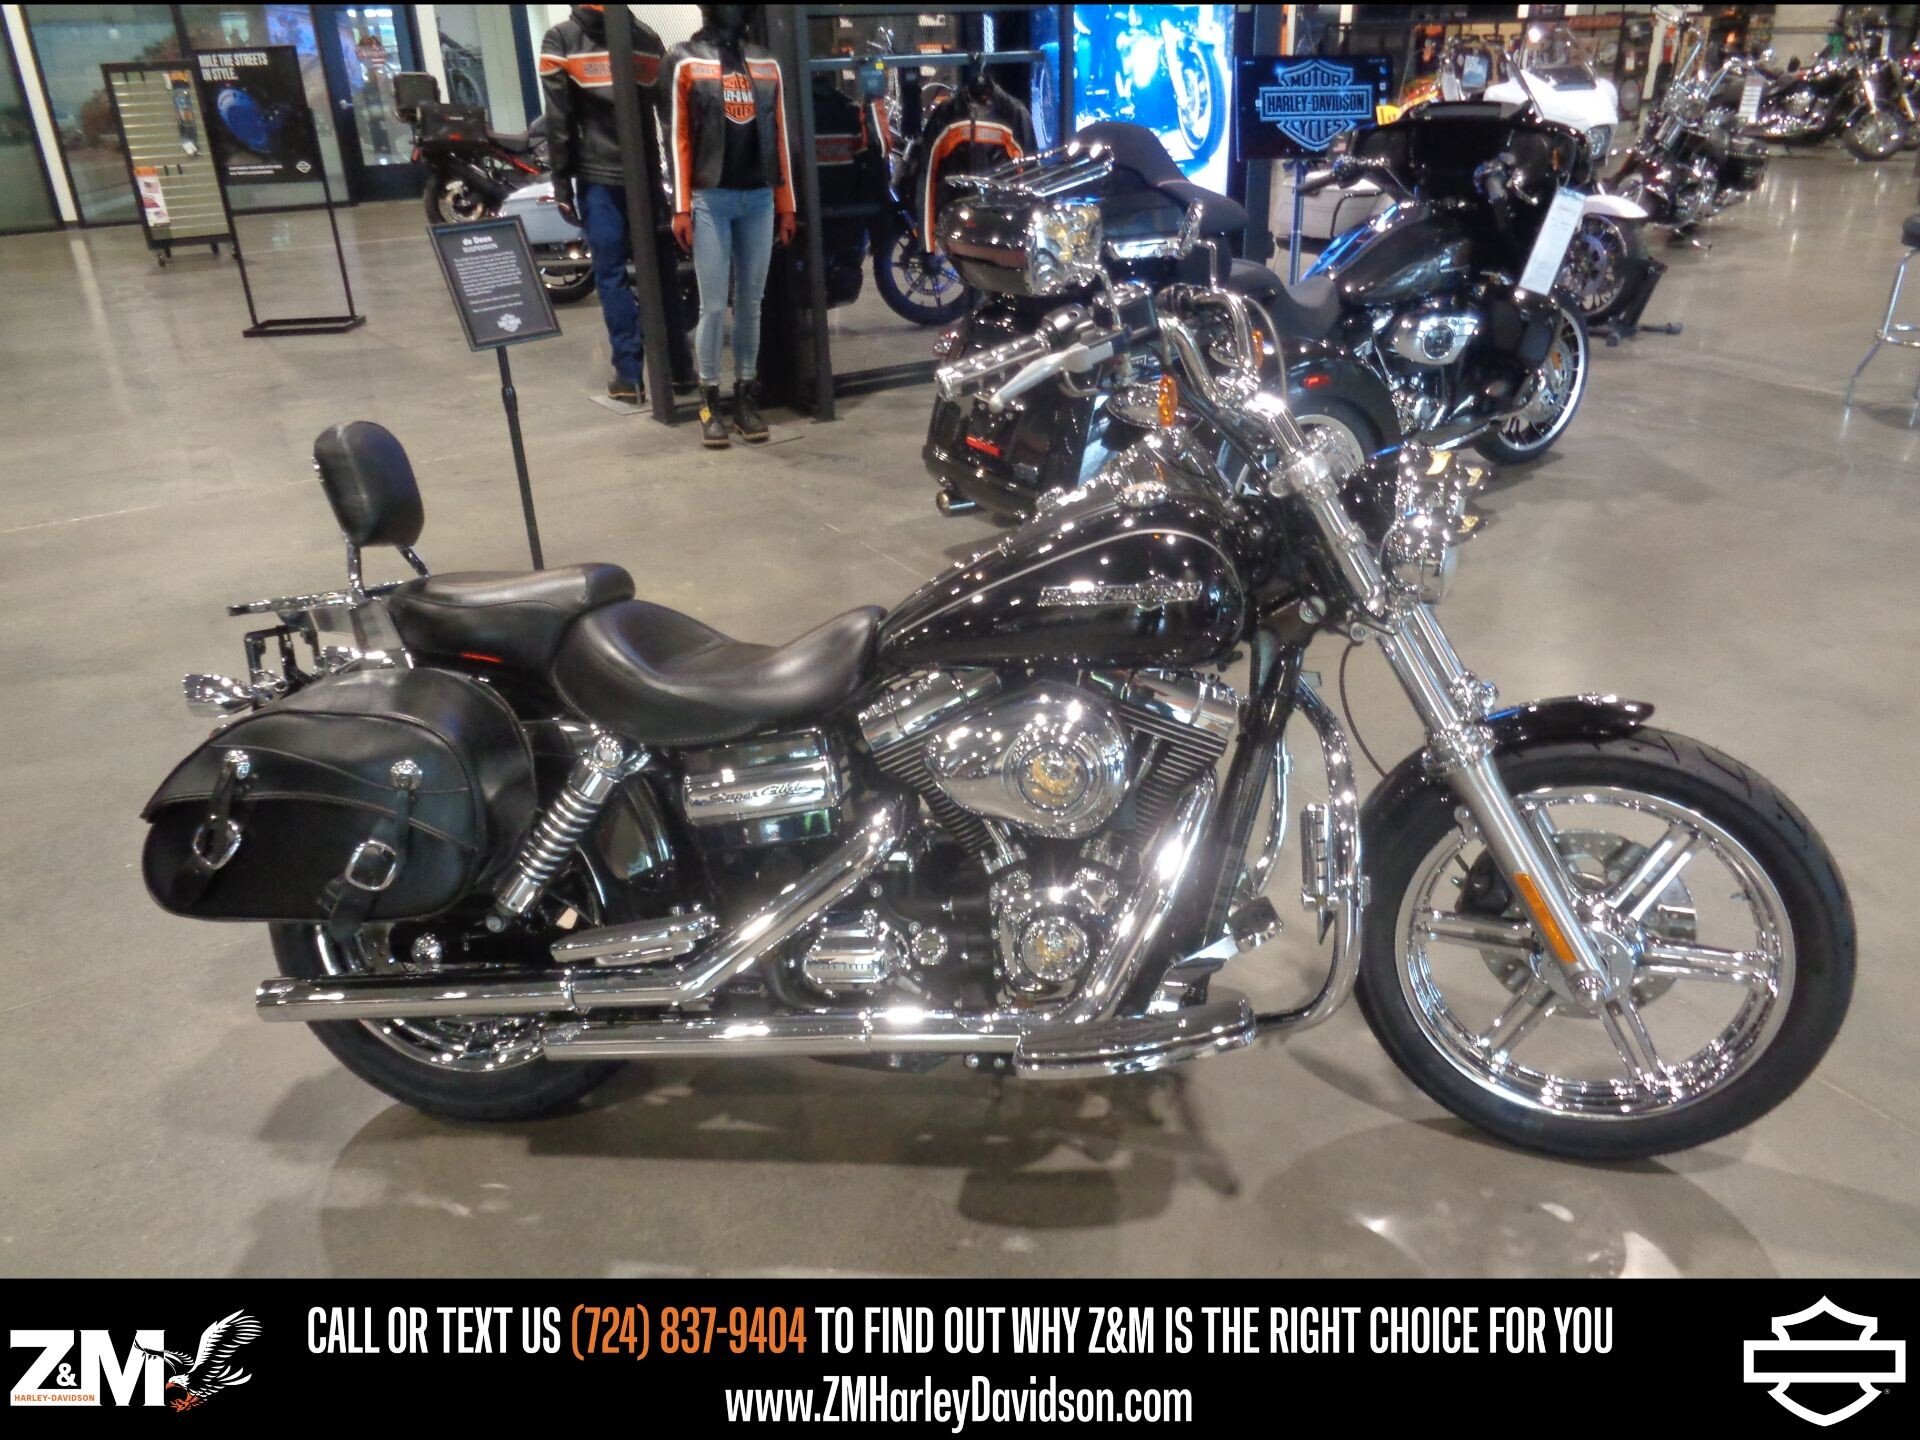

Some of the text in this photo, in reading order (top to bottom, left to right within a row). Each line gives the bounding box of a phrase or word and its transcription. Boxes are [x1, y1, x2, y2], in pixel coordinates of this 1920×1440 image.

[217, 53, 235, 67] THE
[234, 52, 268, 66] STREETS
[210, 68, 239, 80] STYLE.
[1290, 68, 1342, 87] MOTOR
[1267, 94, 1365, 112] HARLEY-DAVIDSON
[1290, 119, 1342, 142] CYCLES
